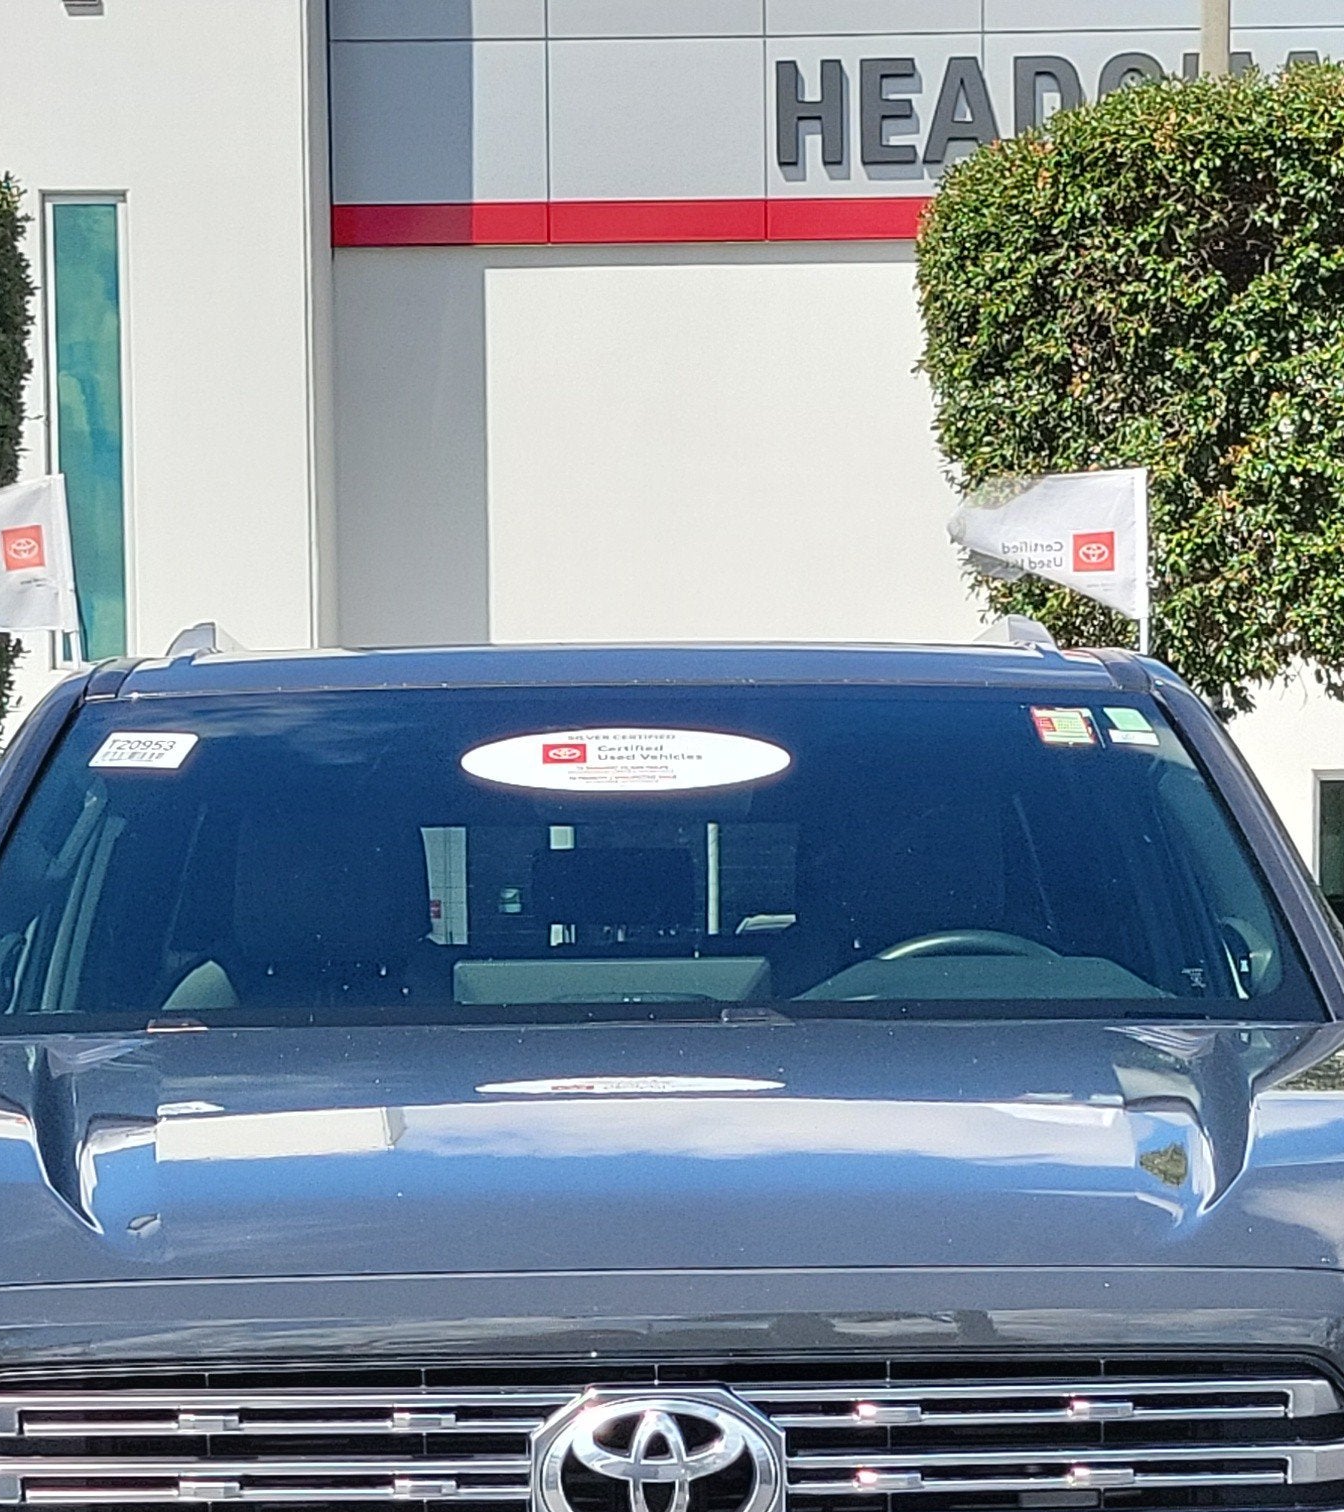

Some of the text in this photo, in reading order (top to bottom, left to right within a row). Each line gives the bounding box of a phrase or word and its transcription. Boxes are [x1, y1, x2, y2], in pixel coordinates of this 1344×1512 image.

[597, 744, 664, 752] Certified
[597, 753, 703, 761] Used Vehicles
